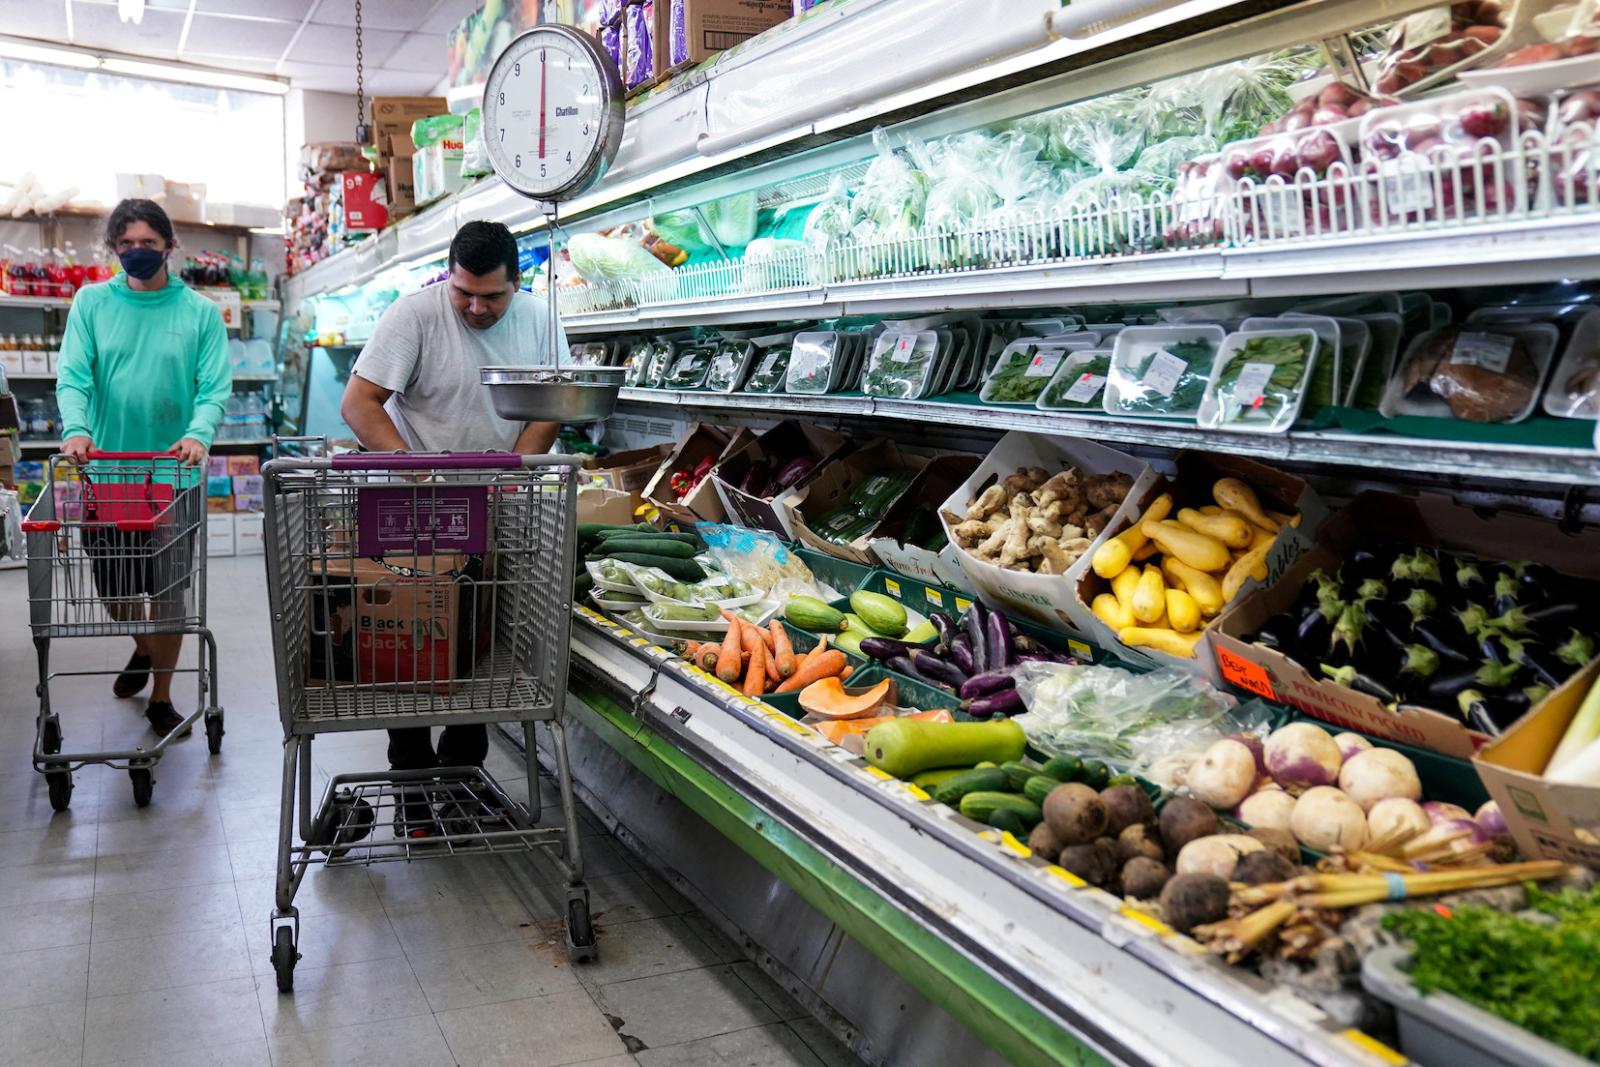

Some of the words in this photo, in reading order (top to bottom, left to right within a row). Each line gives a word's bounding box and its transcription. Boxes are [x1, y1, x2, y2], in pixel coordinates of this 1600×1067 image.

[514, 63, 521, 77] 9
[582, 84, 589, 96] 2
[499, 92, 505, 106] 8
[555, 106, 579, 117] Chatillon
[500, 128, 505, 142] 7
[582, 123, 589, 136] 3
[515, 154, 522, 168] 6
[565, 150, 572, 165] 4
[540, 163, 547, 178] 5
[361, 615, 404, 630] Back
[361, 635, 408, 650] Jack
[1292, 680, 1363, 719] PERFECTLY
[1367, 711, 1426, 742] PICKED
